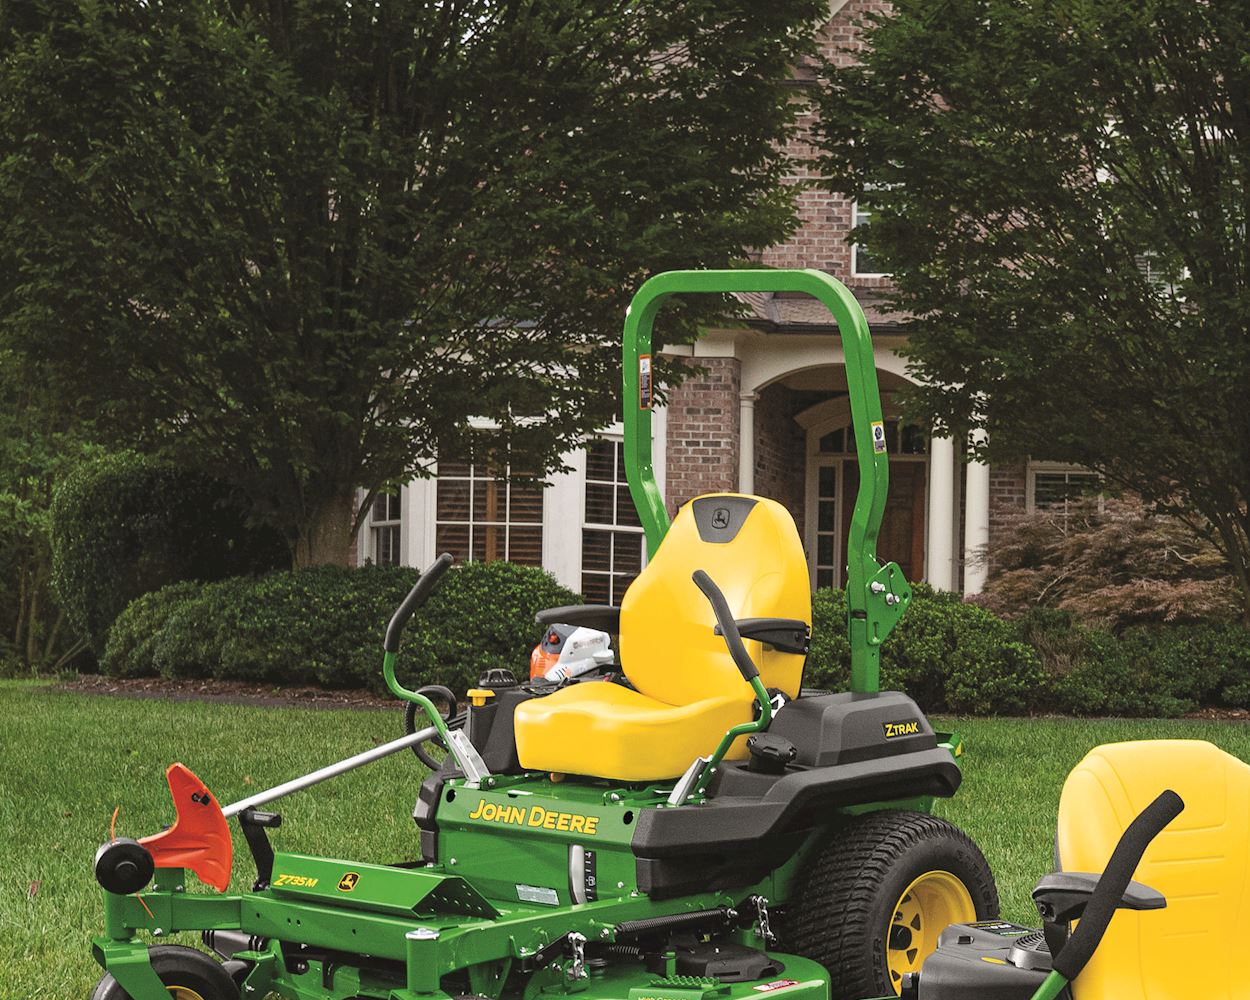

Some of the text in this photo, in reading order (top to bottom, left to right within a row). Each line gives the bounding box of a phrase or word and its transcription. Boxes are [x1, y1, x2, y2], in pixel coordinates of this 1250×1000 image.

[885, 721, 919, 737] ZTRAK
[469, 799, 600, 835] JOHN DEERE
[273, 874, 319, 888] Z735M
